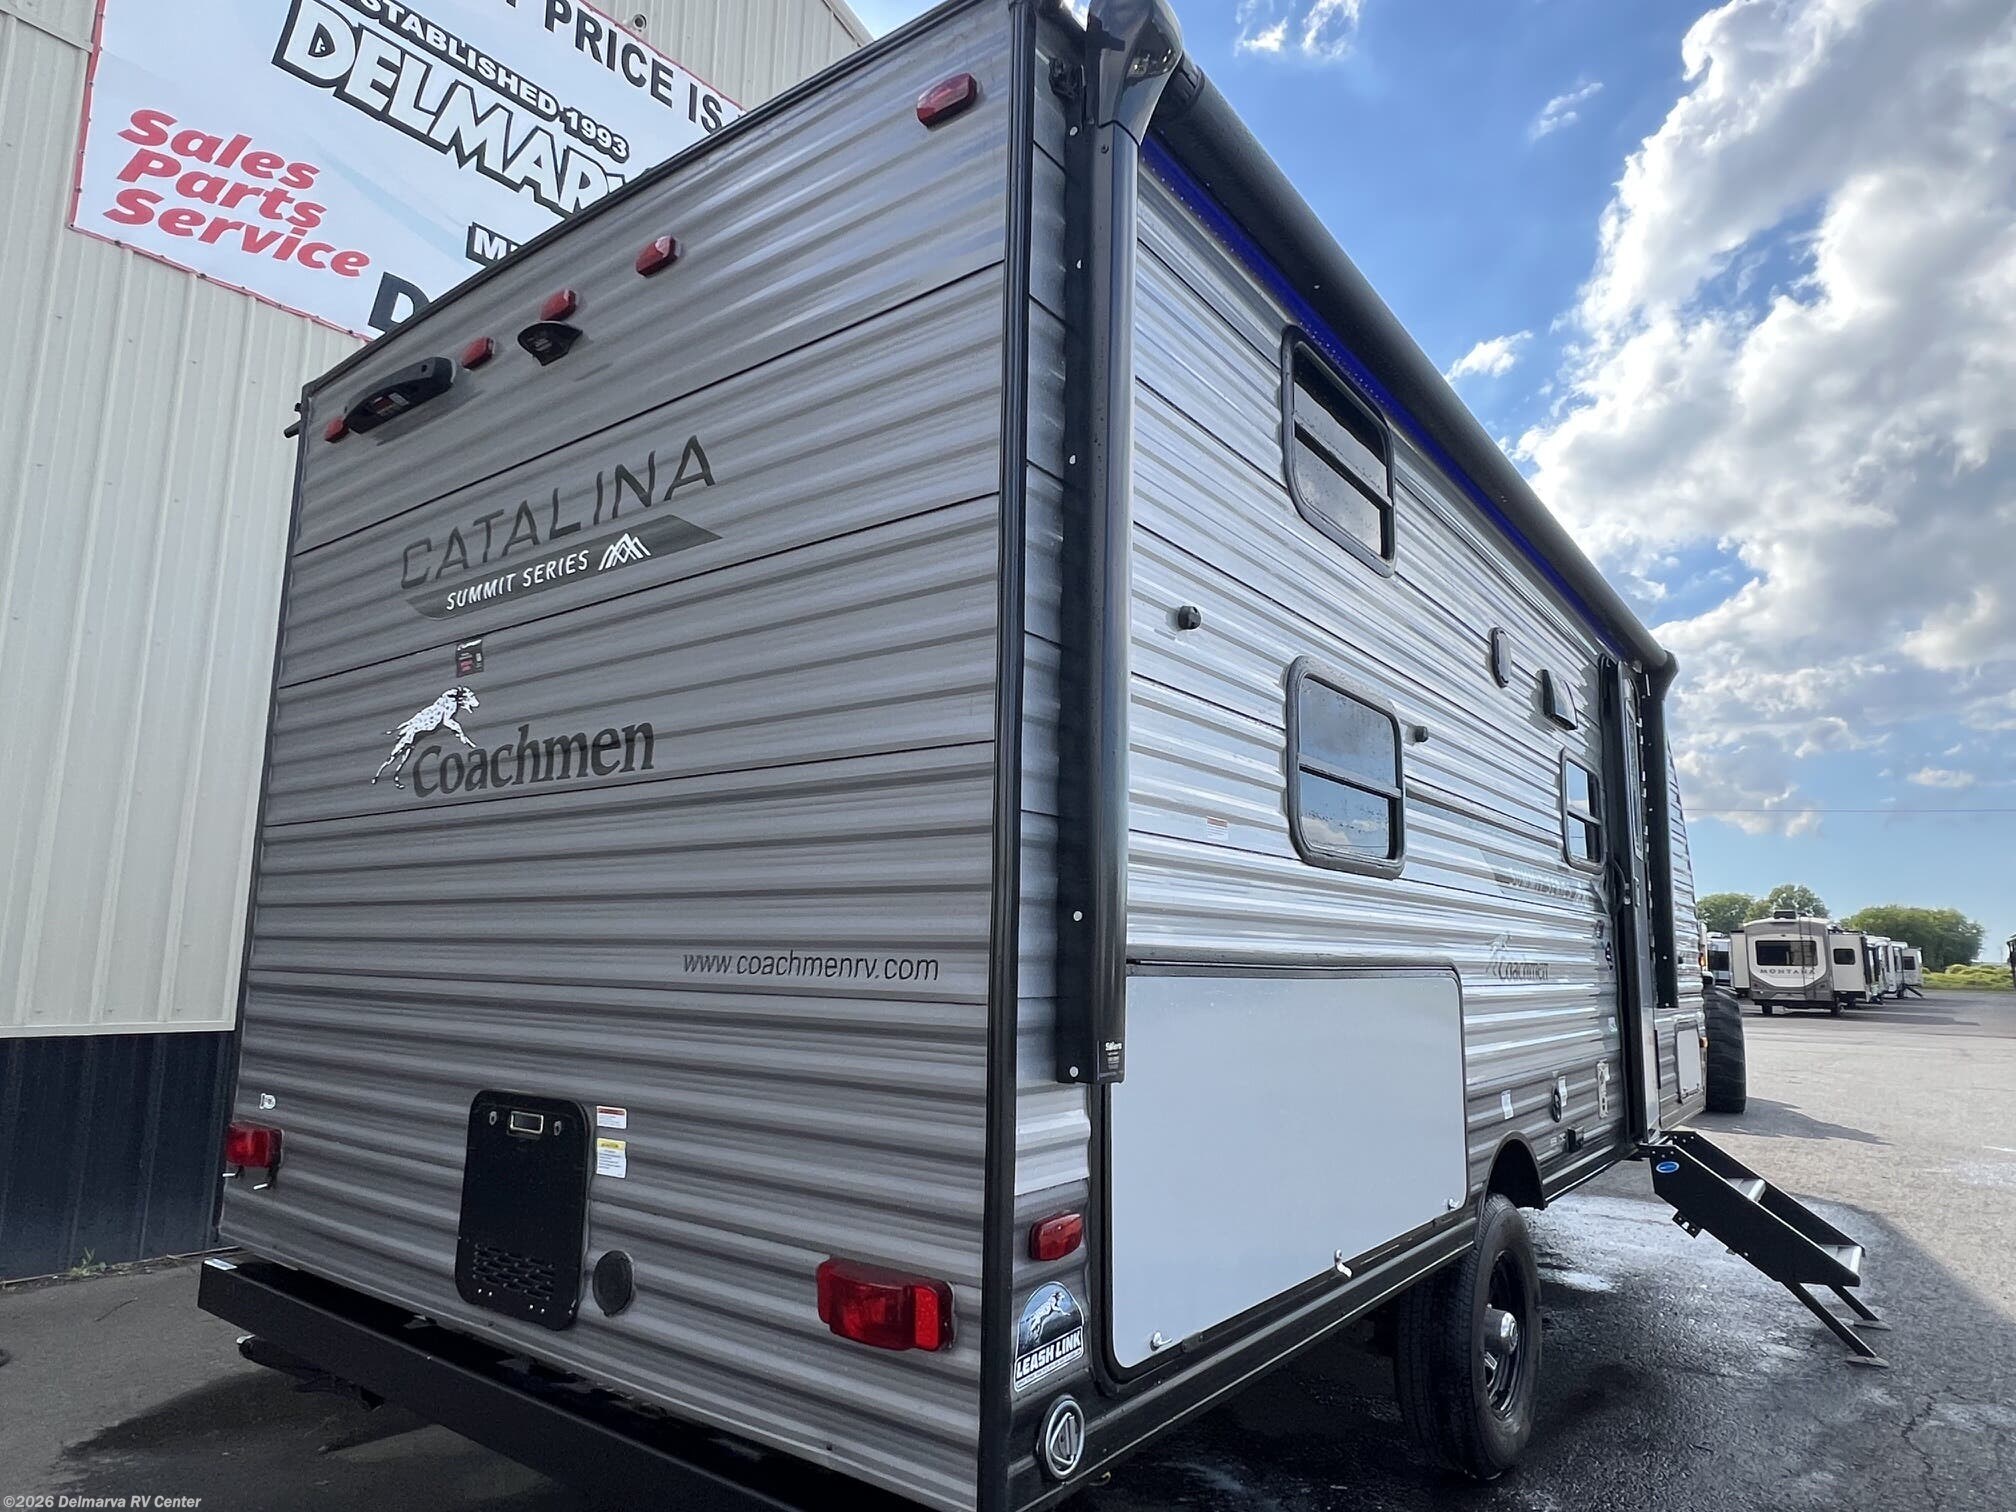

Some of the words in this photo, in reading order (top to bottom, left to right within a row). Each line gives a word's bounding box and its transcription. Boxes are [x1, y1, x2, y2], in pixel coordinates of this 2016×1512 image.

[358, 0, 558, 117] STABLISHED
[565, 108, 628, 160] 1993
[544, 0, 674, 108] PRICE
[689, 82, 723, 135] IS
[116, 148, 327, 228] Parts
[117, 109, 320, 189] Sales
[102, 188, 370, 277] Service
[401, 435, 716, 589] CATALINA
[446, 574, 516, 611] SUMMIT
[522, 550, 589, 587] SERIES
[412, 721, 655, 798] Coachmen
[683, 950, 940, 981] www.coachmenrv.com
[1016, 1344, 1055, 1379] LEASH
[1055, 1330, 1081, 1358] LINK
